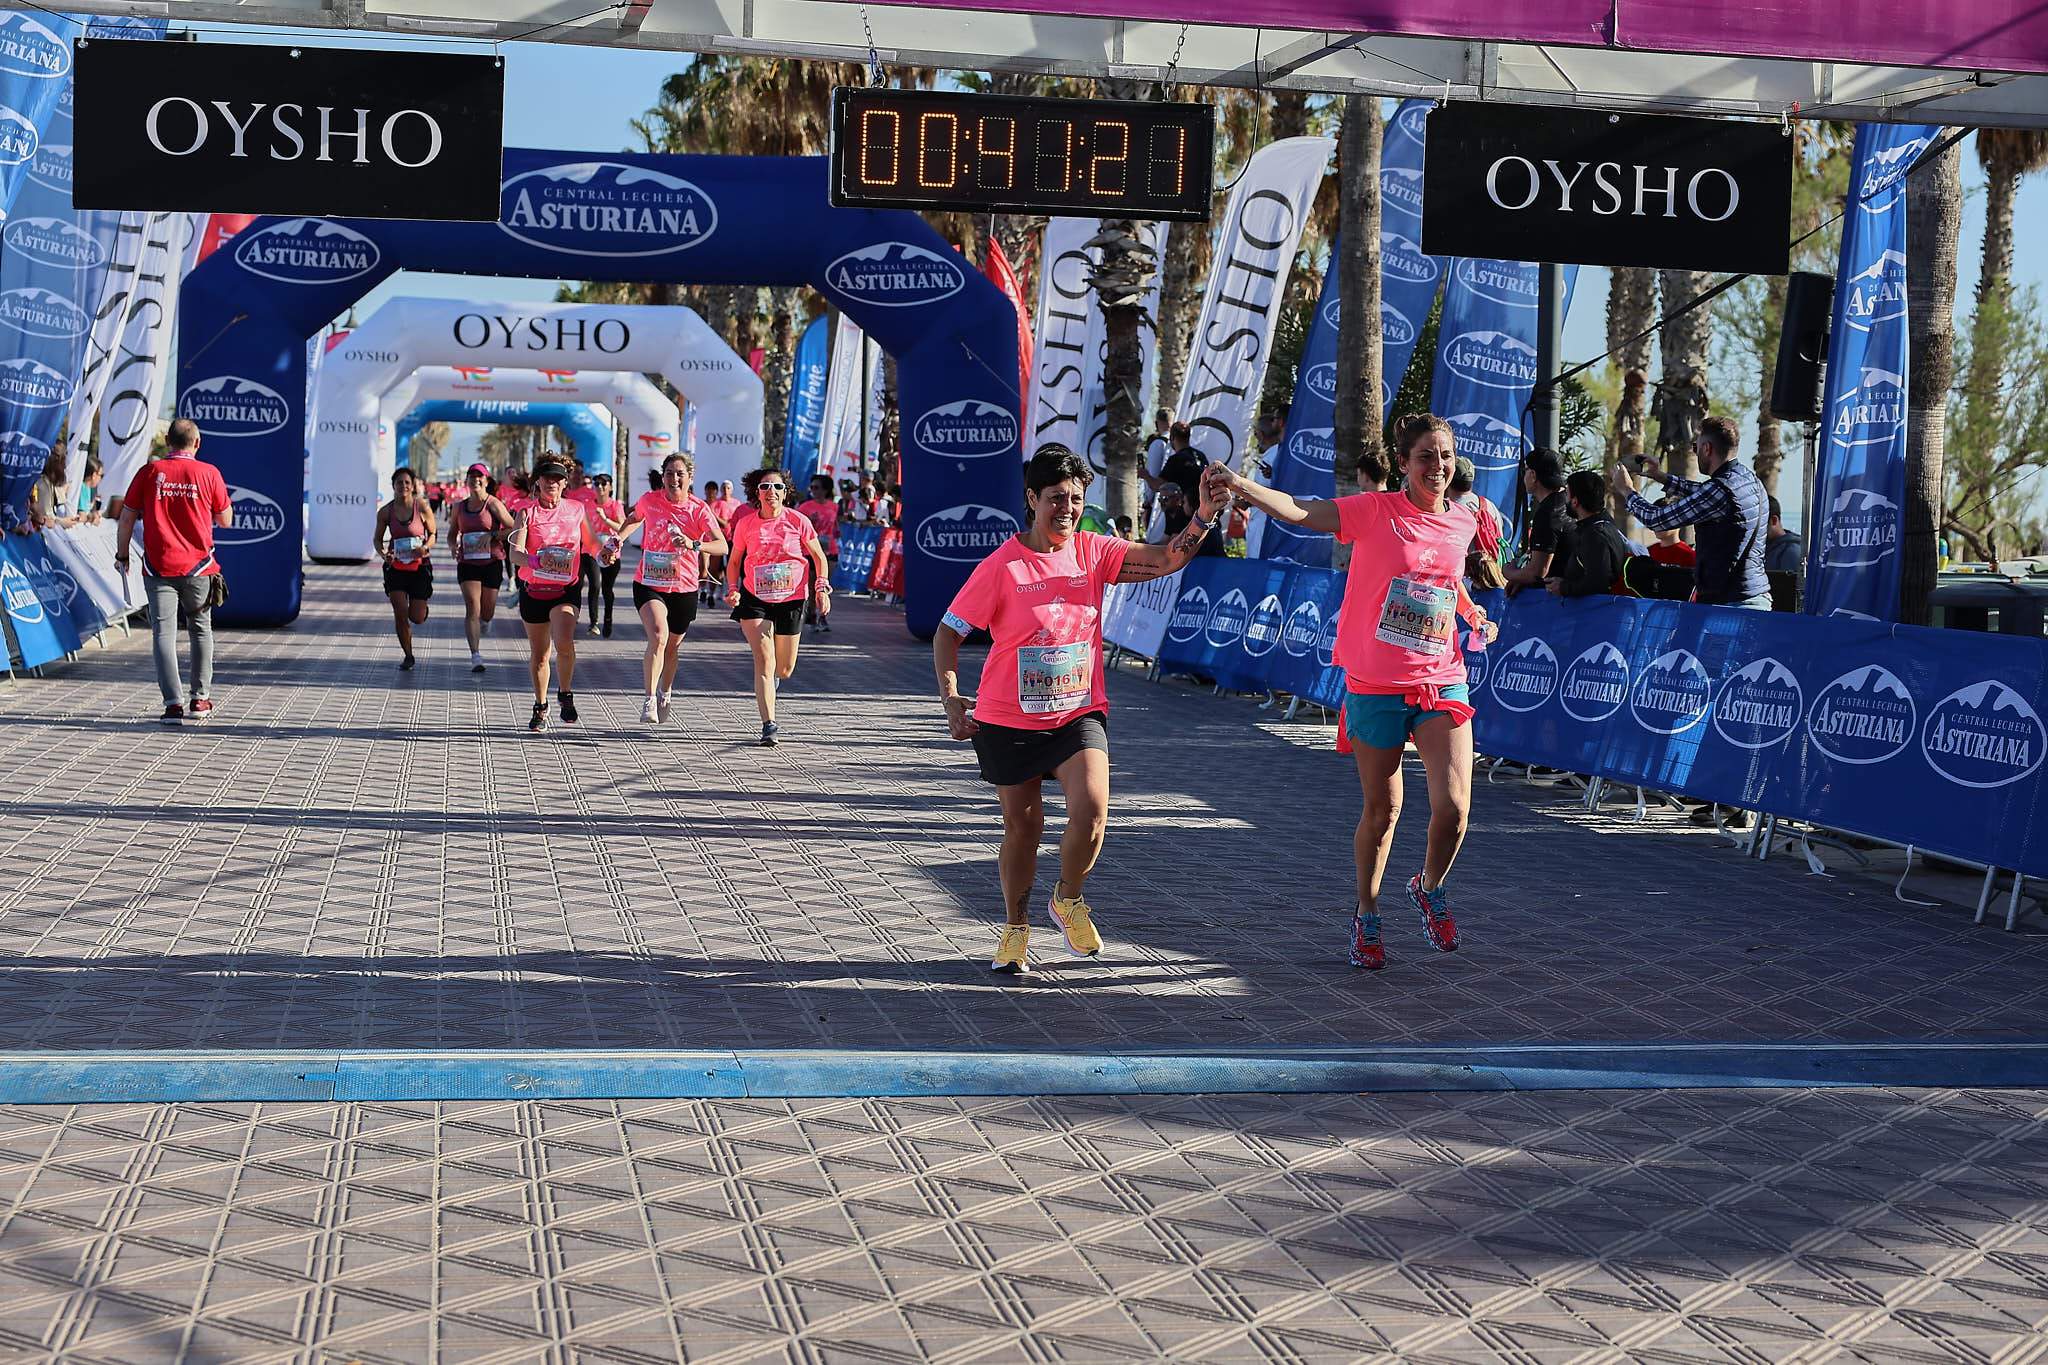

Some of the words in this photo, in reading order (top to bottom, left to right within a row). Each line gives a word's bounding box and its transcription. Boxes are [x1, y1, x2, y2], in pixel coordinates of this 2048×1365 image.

[146, 97, 443, 168] OYSHO
[860, 110, 1186, 197] 00:41:21
[544, 187, 615, 200] CENTRAL
[622, 192, 693, 204] LECHERA
[1486, 155, 1739, 221] OYSHO
[507, 188, 701, 236] ASTURIANA
[11, 227, 97, 264] ASTURIANA
[244, 240, 369, 269] ASTURIANA
[268, 238, 314, 248] CENTRAL
[837, 266, 957, 291] ASTURIANA
[855, 263, 901, 272] CENTRAL
[0, 298, 81, 332] ASTURIANA
[453, 313, 630, 354] OYSHO
[345, 351, 399, 363] OYSHO
[681, 359, 733, 372] OYSHO
[1034, 249, 1097, 456] YSHO
[184, 397, 282, 424] ASTURIANA
[796, 364, 827, 443] Marlene
[319, 422, 369, 433] OYSHO
[706, 432, 755, 446] OYSHO
[921, 421, 1013, 444] ASTURIANA
[316, 493, 367, 506] OYSHO
[1017, 582, 1047, 594] OYSHO
[1494, 662, 1551, 695] ASTURIANA
[1563, 669, 1622, 704] ASTURIANA
[1634, 677, 1702, 715] ASTURIANA
[1717, 687, 1793, 728] ASTURIANA
[1765, 689, 1795, 700] LECHERA
[1837, 696, 1870, 709] CENTRAL
[1872, 699, 1908, 713] LECHERA
[1813, 697, 1905, 744] ASTURIANA
[1951, 713, 1989, 728] CENTRAL
[1992, 717, 2032, 734] LECHERA
[1928, 713, 2030, 768] ASTURIANA
